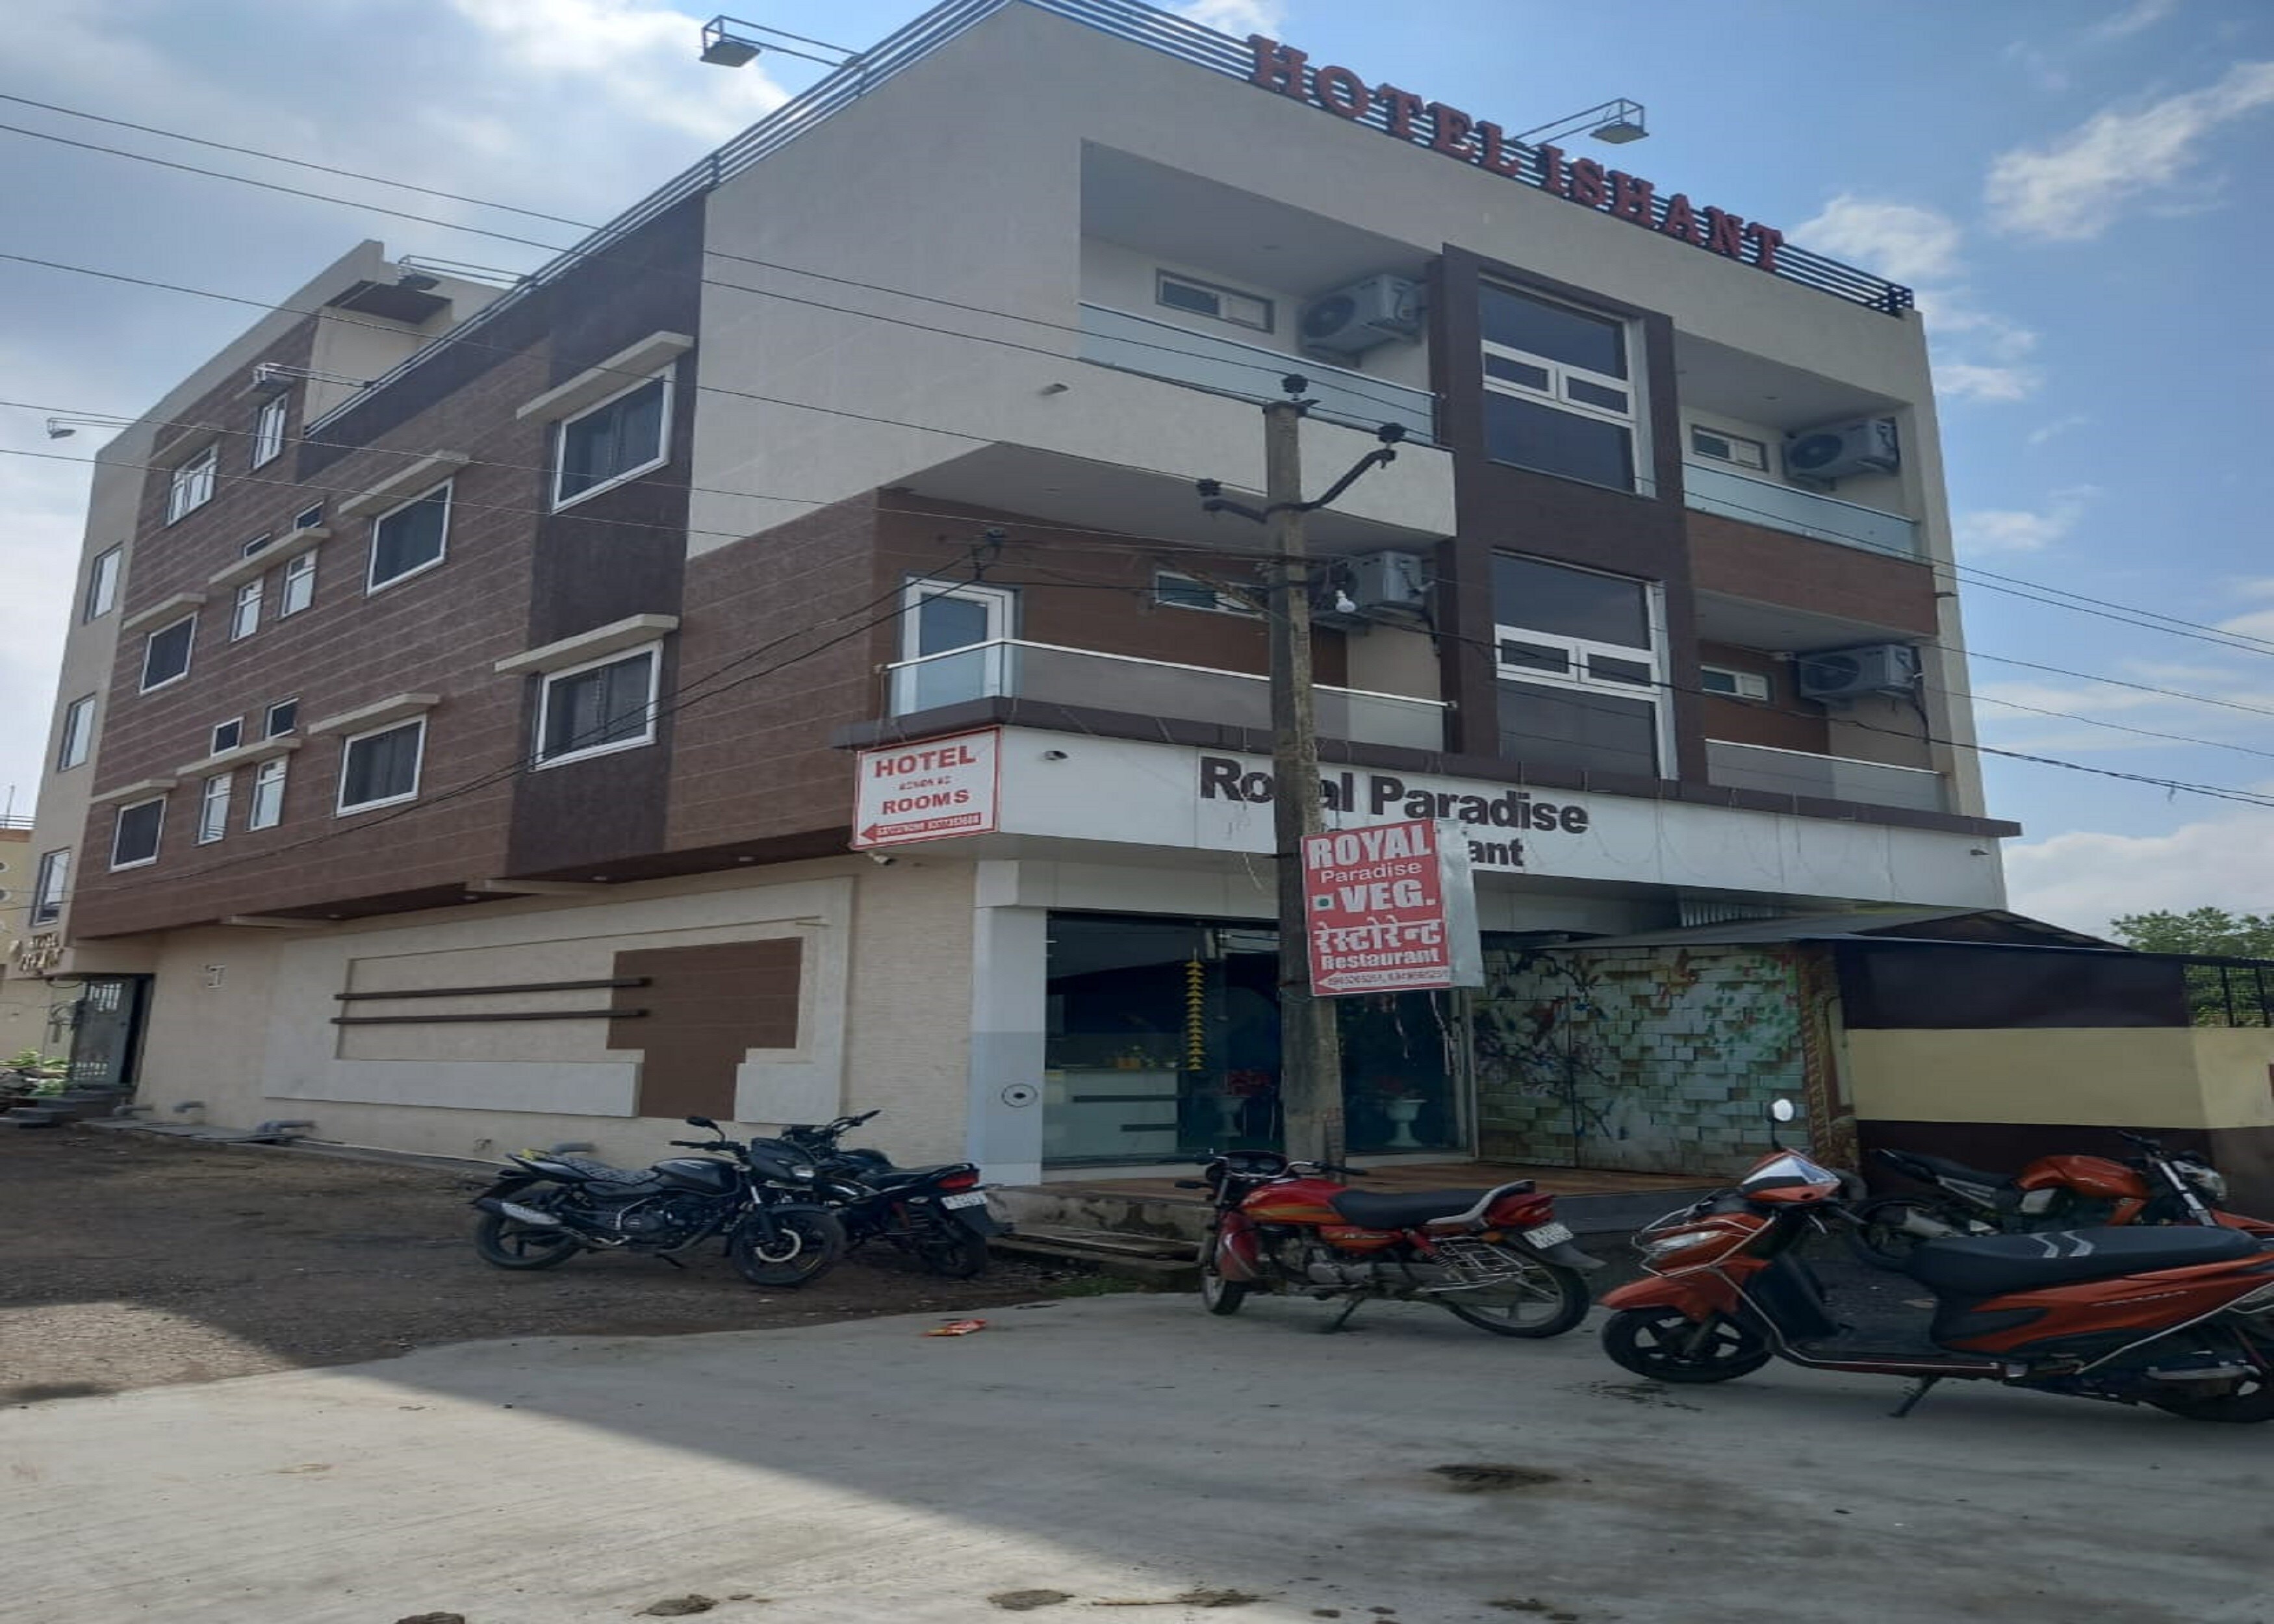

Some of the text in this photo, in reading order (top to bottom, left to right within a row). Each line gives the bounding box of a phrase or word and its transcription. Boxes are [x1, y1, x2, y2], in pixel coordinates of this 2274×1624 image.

[1246, 34, 1783, 272] HOTEL ISHANT
[875, 746, 976, 778] HOTEL
[882, 789, 969, 815] ROOMS
[1201, 756, 1589, 833] Roal Paradise
[1307, 824, 1431, 869] ROYAL
[1320, 862, 1422, 883] Paradise
[1338, 880, 1436, 913] VEG.
[1320, 948, 1440, 971] Restaurant
